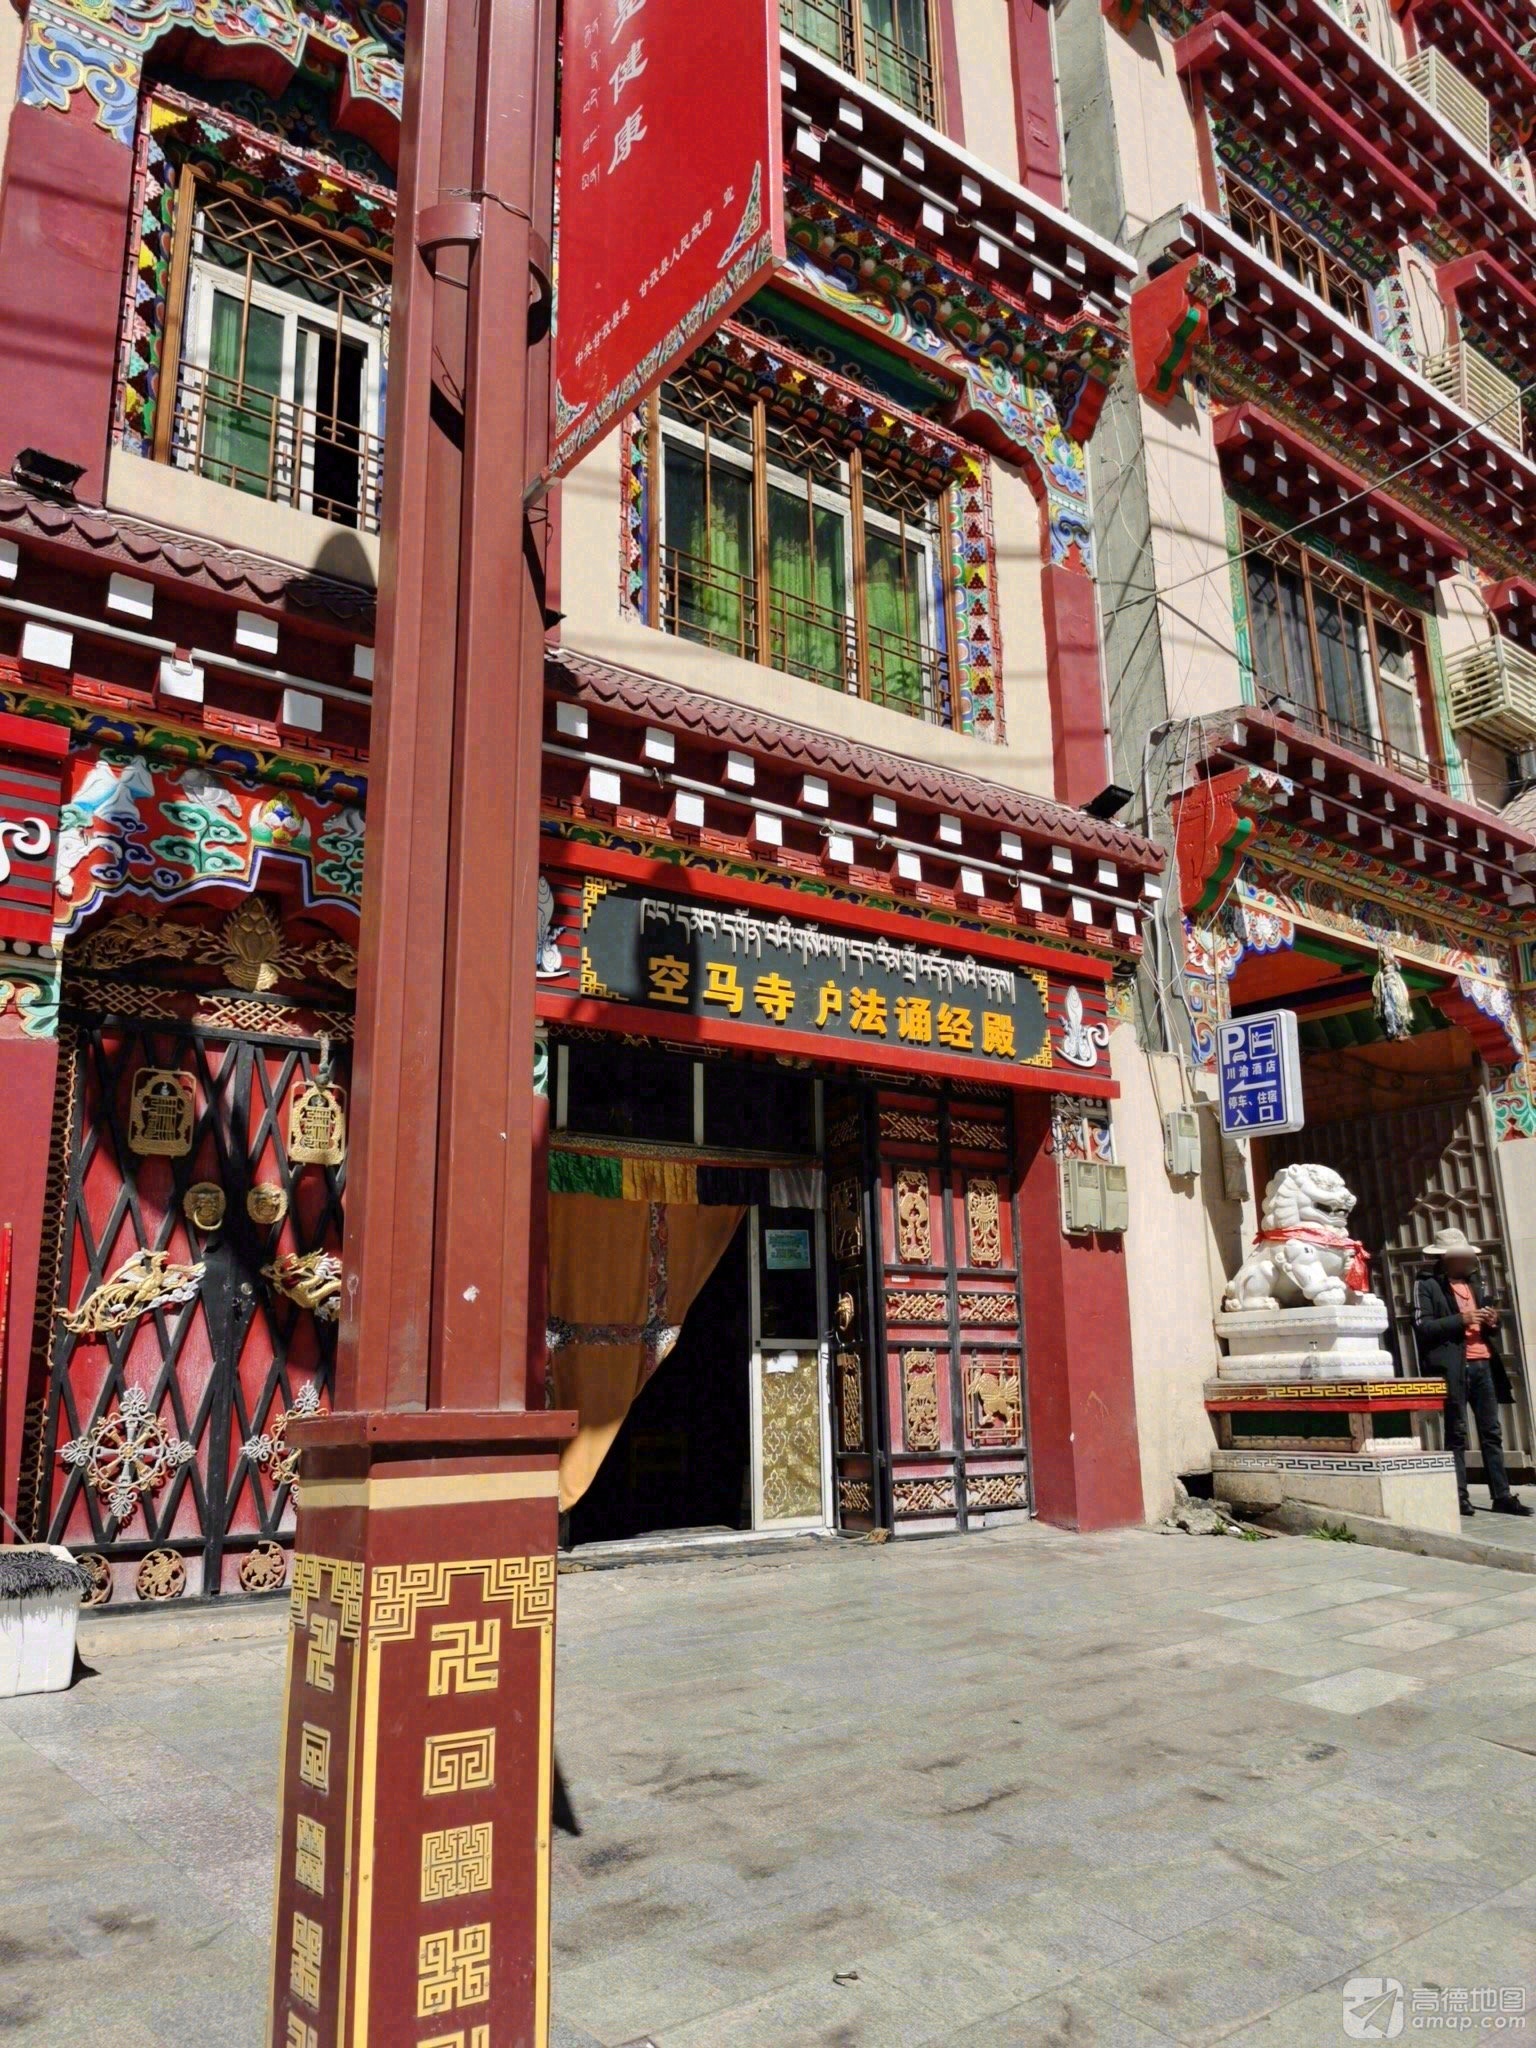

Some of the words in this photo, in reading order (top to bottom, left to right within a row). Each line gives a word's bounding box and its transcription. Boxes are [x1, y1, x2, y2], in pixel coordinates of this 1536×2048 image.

[639, 209, 712, 297] 甘孜县人民政府
[723, 186, 735, 208] 宣
[1221, 1026, 1246, 1066] P
[1226, 1060, 1276, 1080] 川渝酒店
[1234, 1106, 1274, 1126] 入口
